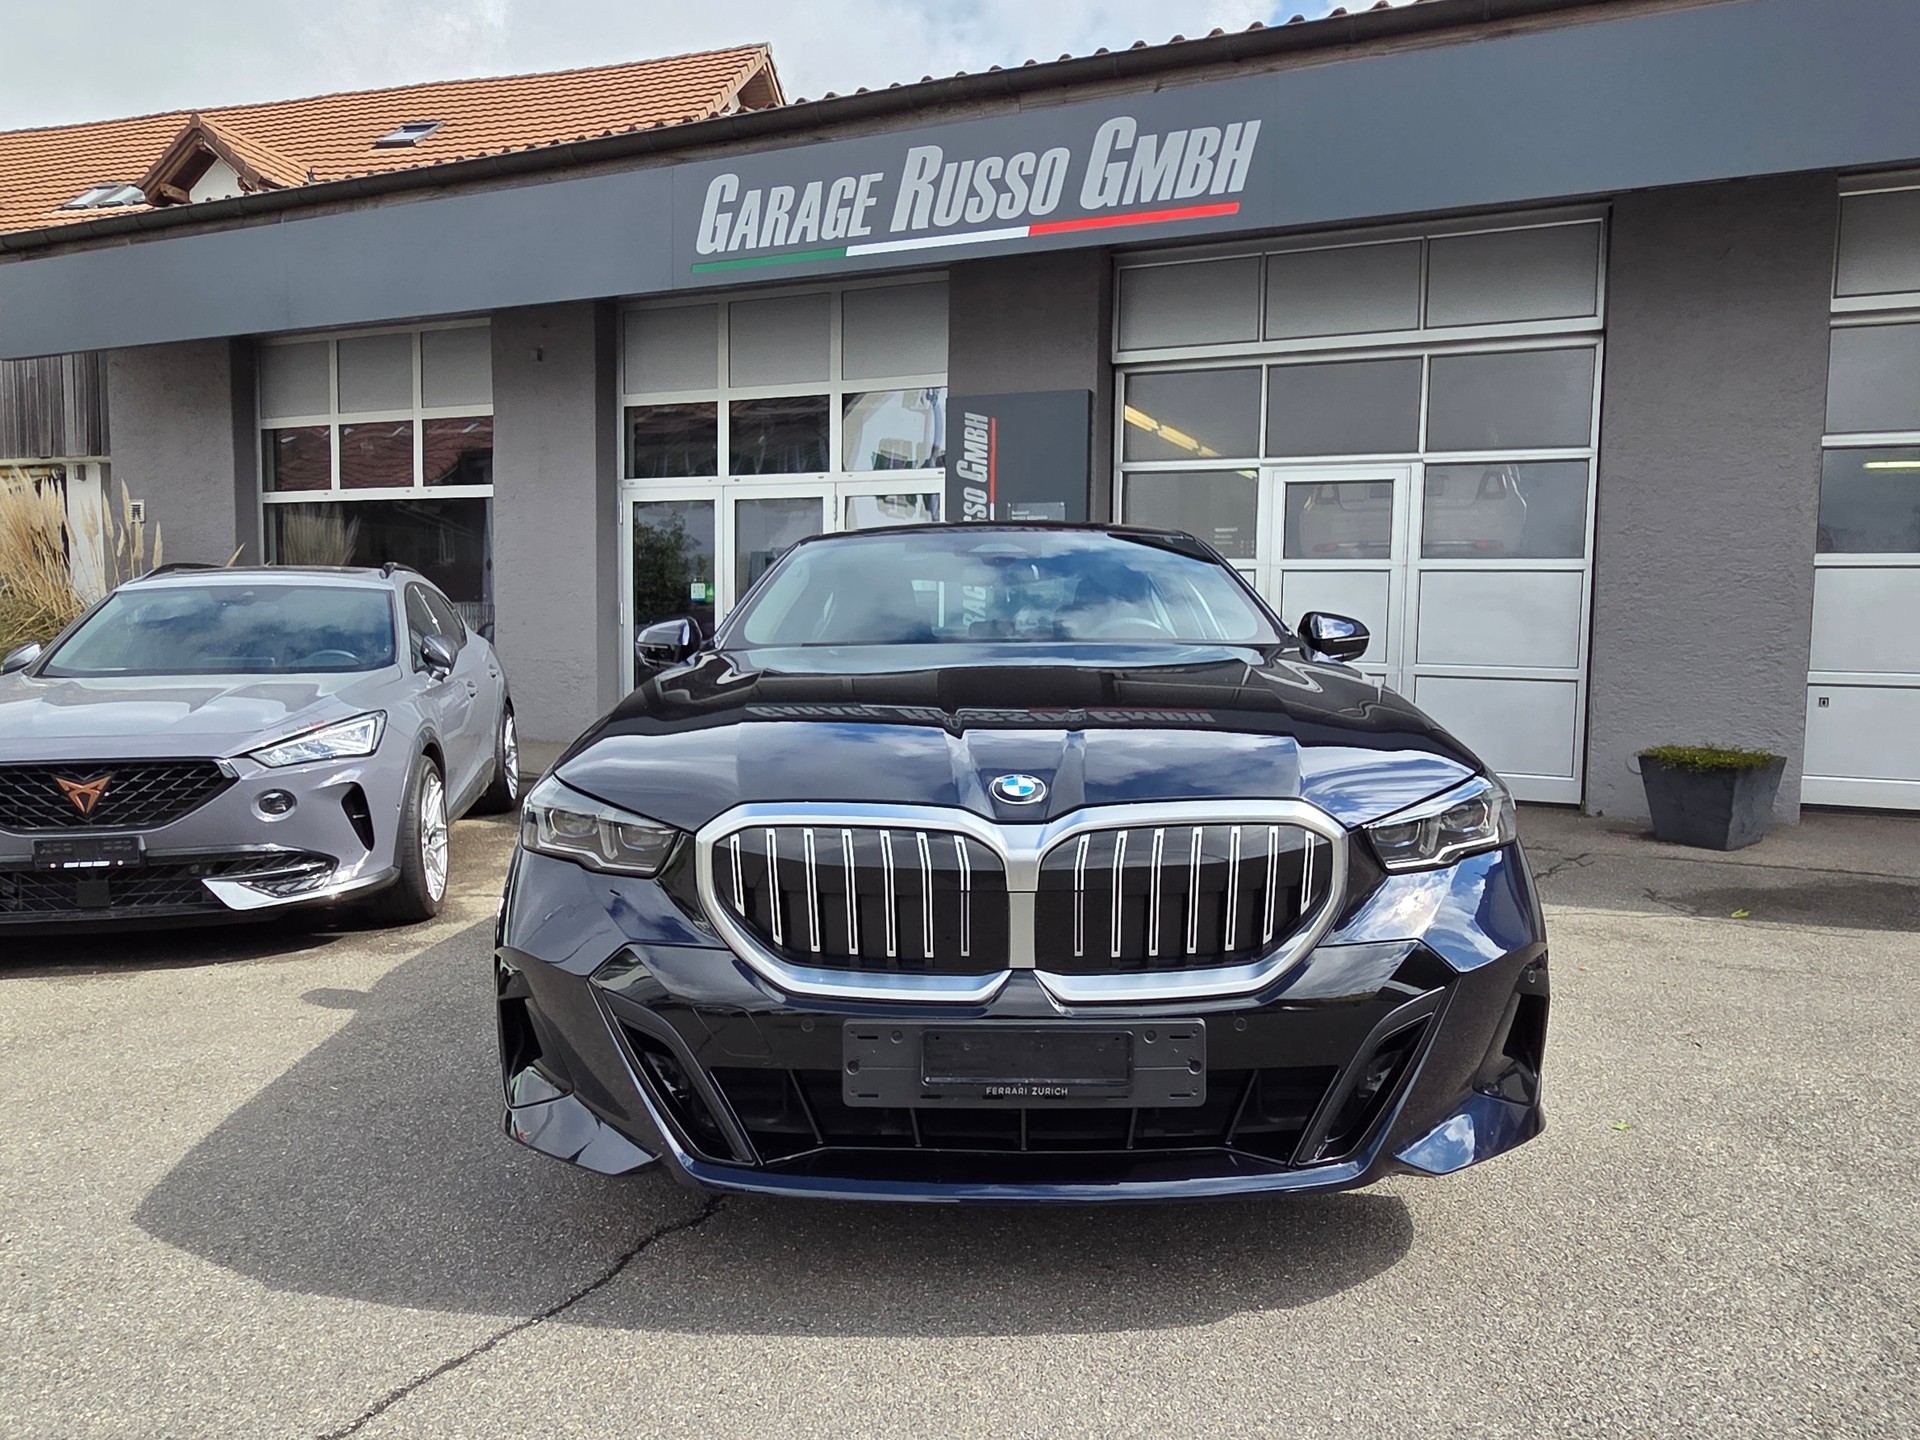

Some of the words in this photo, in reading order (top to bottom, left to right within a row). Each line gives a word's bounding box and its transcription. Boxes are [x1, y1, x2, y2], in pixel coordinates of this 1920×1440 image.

[696, 173, 884, 255] GARAGE
[890, 144, 1071, 233] RUSSO
[1080, 116, 1262, 210] GMBH
[956, 411, 989, 483] GMBH
[986, 1086, 1028, 1096] FERRARI
[1031, 1086, 1068, 1096] ZURICH
